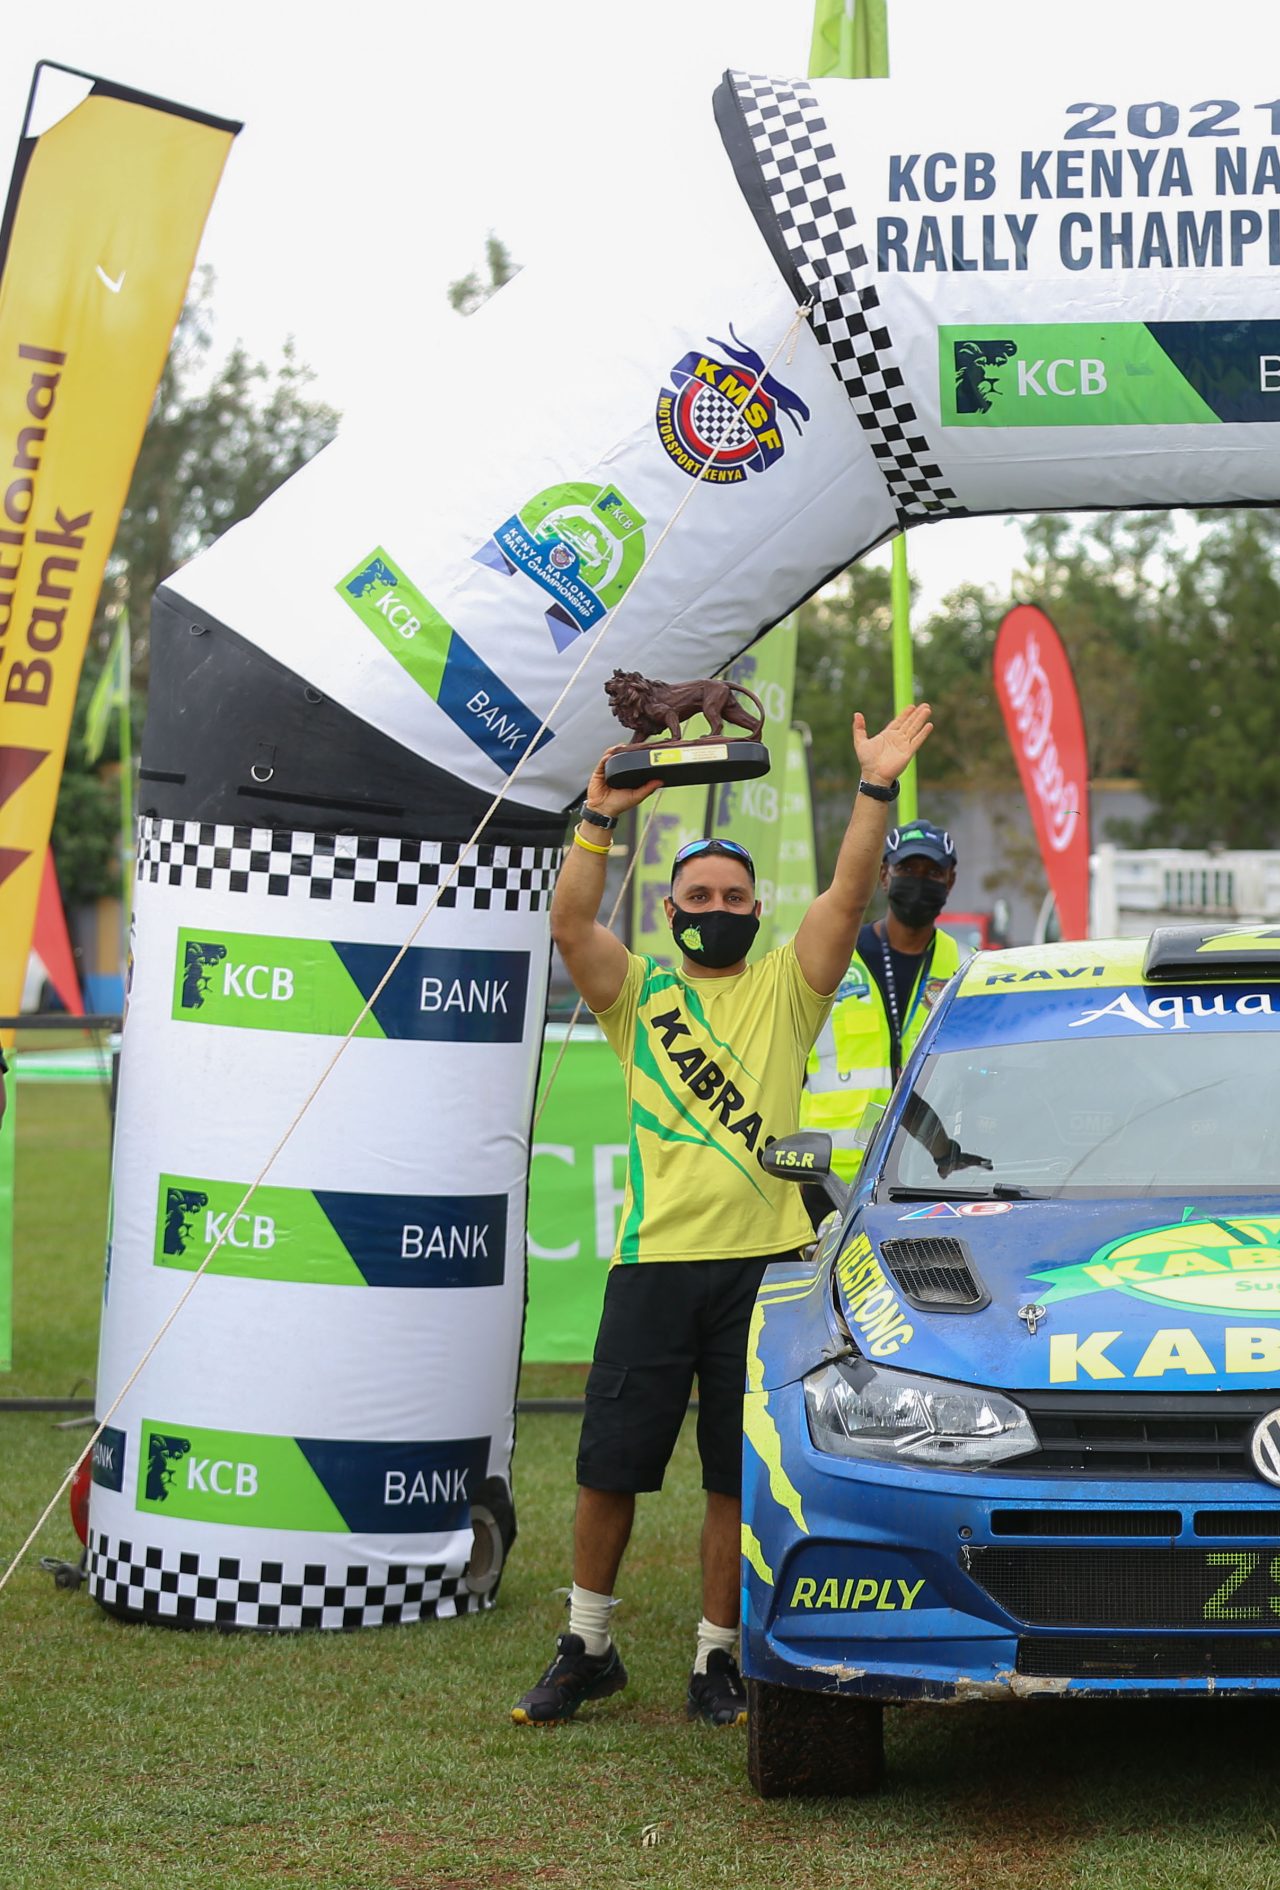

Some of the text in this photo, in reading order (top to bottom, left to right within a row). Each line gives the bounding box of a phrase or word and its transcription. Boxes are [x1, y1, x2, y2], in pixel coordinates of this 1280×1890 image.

[888, 151, 997, 204] KCB
[1019, 145, 1194, 201] KENYA
[876, 212, 1039, 273] RALLY
[1015, 357, 1108, 398] KCB
[694, 357, 782, 450] KMSF
[659, 397, 743, 481] MOTORSPORT KENYA
[612, 507, 634, 530] KCB
[502, 533, 591, 618] RALLY CHAMPIONSHIP
[509, 527, 596, 614] KENYA NATIONAL
[5, 504, 93, 706] Bank
[375, 590, 528, 751] KCB BANK
[222, 963, 510, 1013] KCB BANK
[984, 965, 1105, 987] RAVI
[775, 1150, 815, 1169] T.S.R
[204, 1210, 490, 1260] KCB BANK
[93, 1442, 114, 1471] ANK
[187, 1457, 469, 1505] KCB BANK
[790, 1577, 926, 1610] RAIPLY
